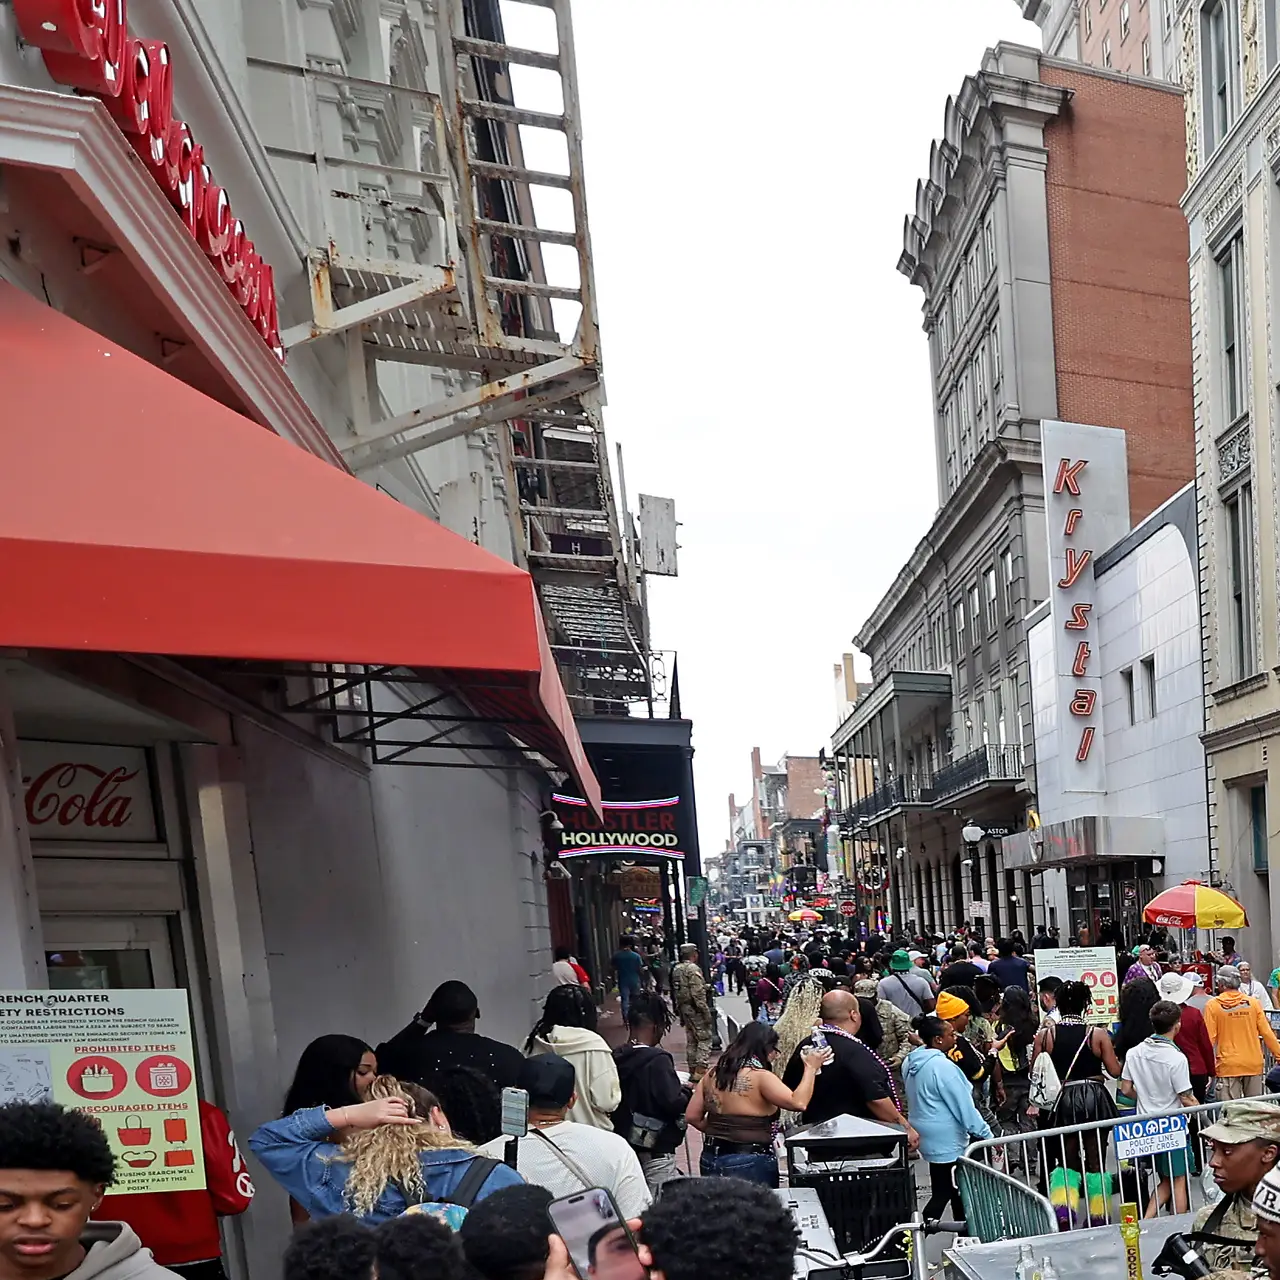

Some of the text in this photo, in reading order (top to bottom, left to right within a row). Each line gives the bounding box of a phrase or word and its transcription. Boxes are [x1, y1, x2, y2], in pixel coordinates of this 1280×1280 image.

[1053, 458, 1098, 762] Krystal
[562, 811, 676, 831] HUSTLER
[561, 831, 678, 847] HOLLYWOOD
[840, 904, 857, 913] STOP
[47, 994, 110, 1003] QUARTER
[26, 1007, 125, 1017] RESTRICTIONS
[74, 1044, 176, 1053] PROHIBITED ITEMS
[157, 1102, 189, 1111] ITEMS
[1125, 1147, 1136, 1156] DO
[1157, 1140, 1180, 1151] CROSS
[1130, 1133, 1174, 1148] POLICE LINE
[1127, 1248, 1138, 1277] COCK
